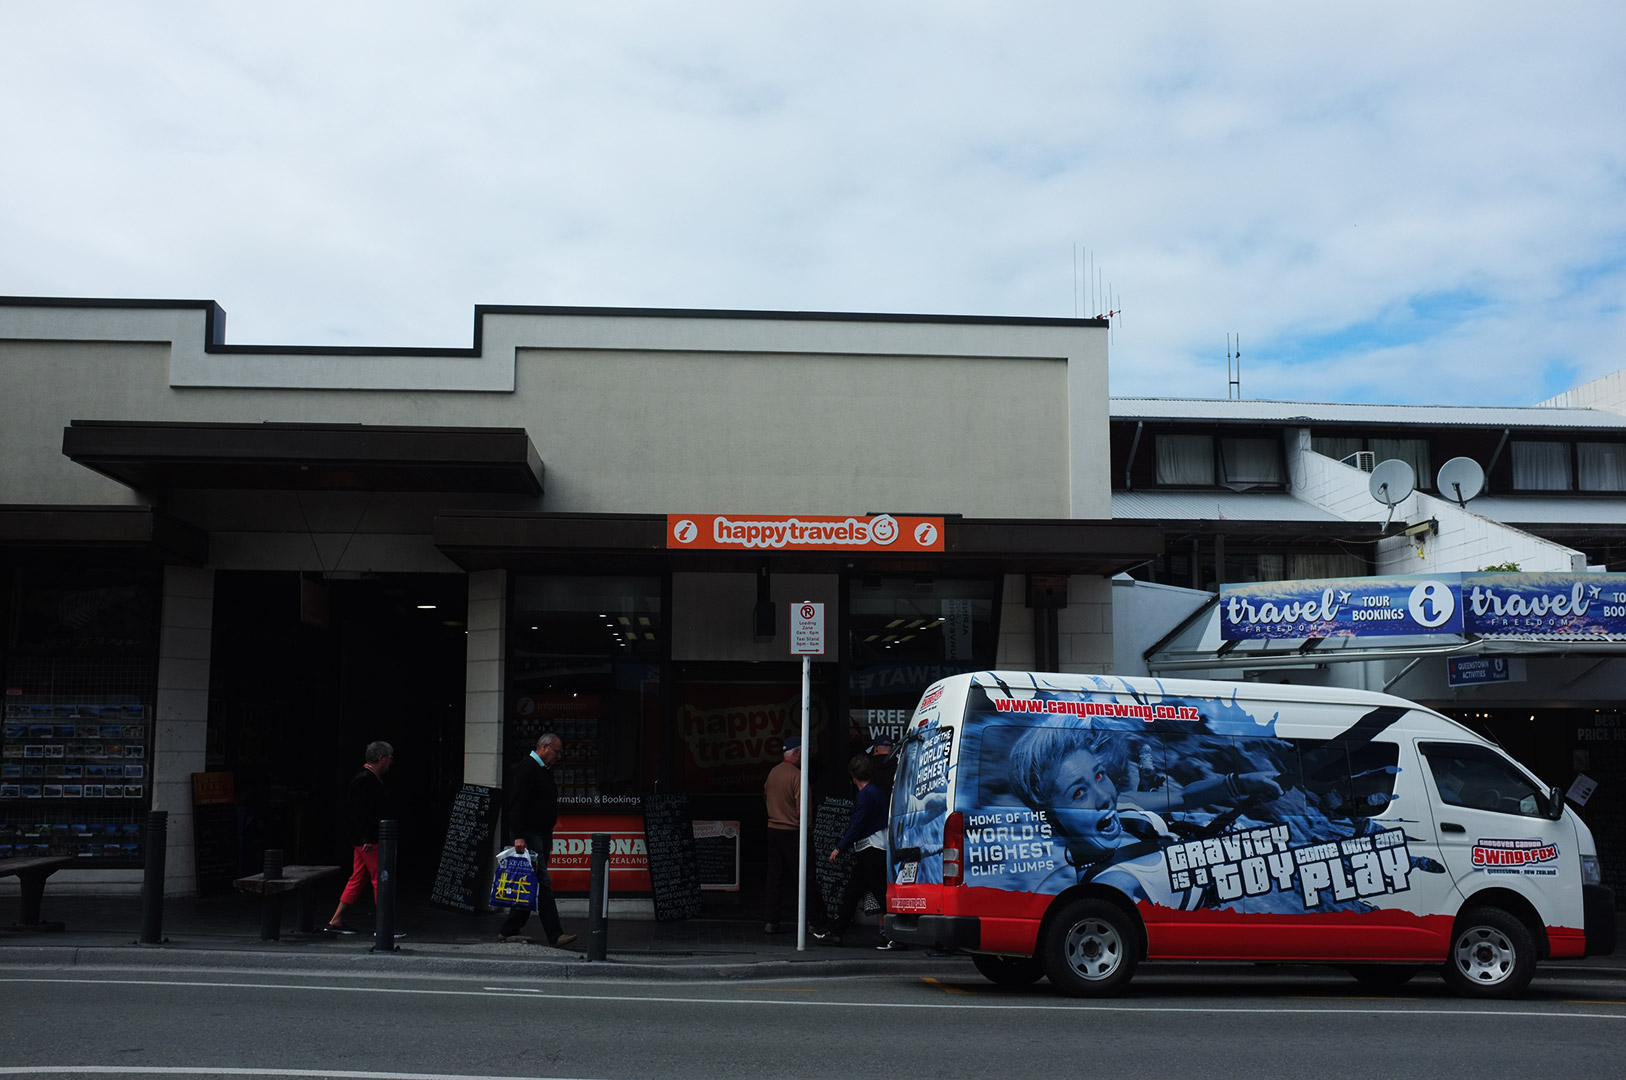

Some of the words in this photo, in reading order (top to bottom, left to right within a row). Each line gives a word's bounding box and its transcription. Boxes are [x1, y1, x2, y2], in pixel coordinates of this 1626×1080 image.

[1227, 588, 1341, 625] travel
[1362, 596, 1390, 608] TOUR
[1470, 581, 1590, 617] travel
[1352, 608, 1405, 622] BOOKINGS
[1603, 605, 1626, 617] BOO
[1245, 624, 1318, 633] FREEDOM
[1491, 618, 1569, 626] FREEDOM
[1457, 660, 1489, 671] QUEENSTOWN
[1462, 669, 1487, 679] ACTIVITIES
[867, 709, 906, 724] FREE
[995, 698, 1200, 722] www.canyonswing.co.nz
[685, 710, 786, 739] happy
[1594, 714, 1621, 727] BEST
[868, 725, 904, 741] WIFI
[1577, 728, 1609, 741] PRICE
[697, 729, 793, 762] trave
[917, 758, 949, 784] HIGHEST
[602, 794, 641, 806] Bookings
[969, 813, 1002, 826] HOME
[1005, 812, 1020, 823] OF
[1023, 811, 1047, 822] THE
[966, 823, 1052, 844] WORLD'S
[968, 841, 1054, 863] HIGHEST
[551, 857, 582, 865] RESORT
[610, 857, 648, 865] ZEALAND
[971, 863, 1006, 877] CLIFF
[1009, 860, 1055, 874] JUMPS
